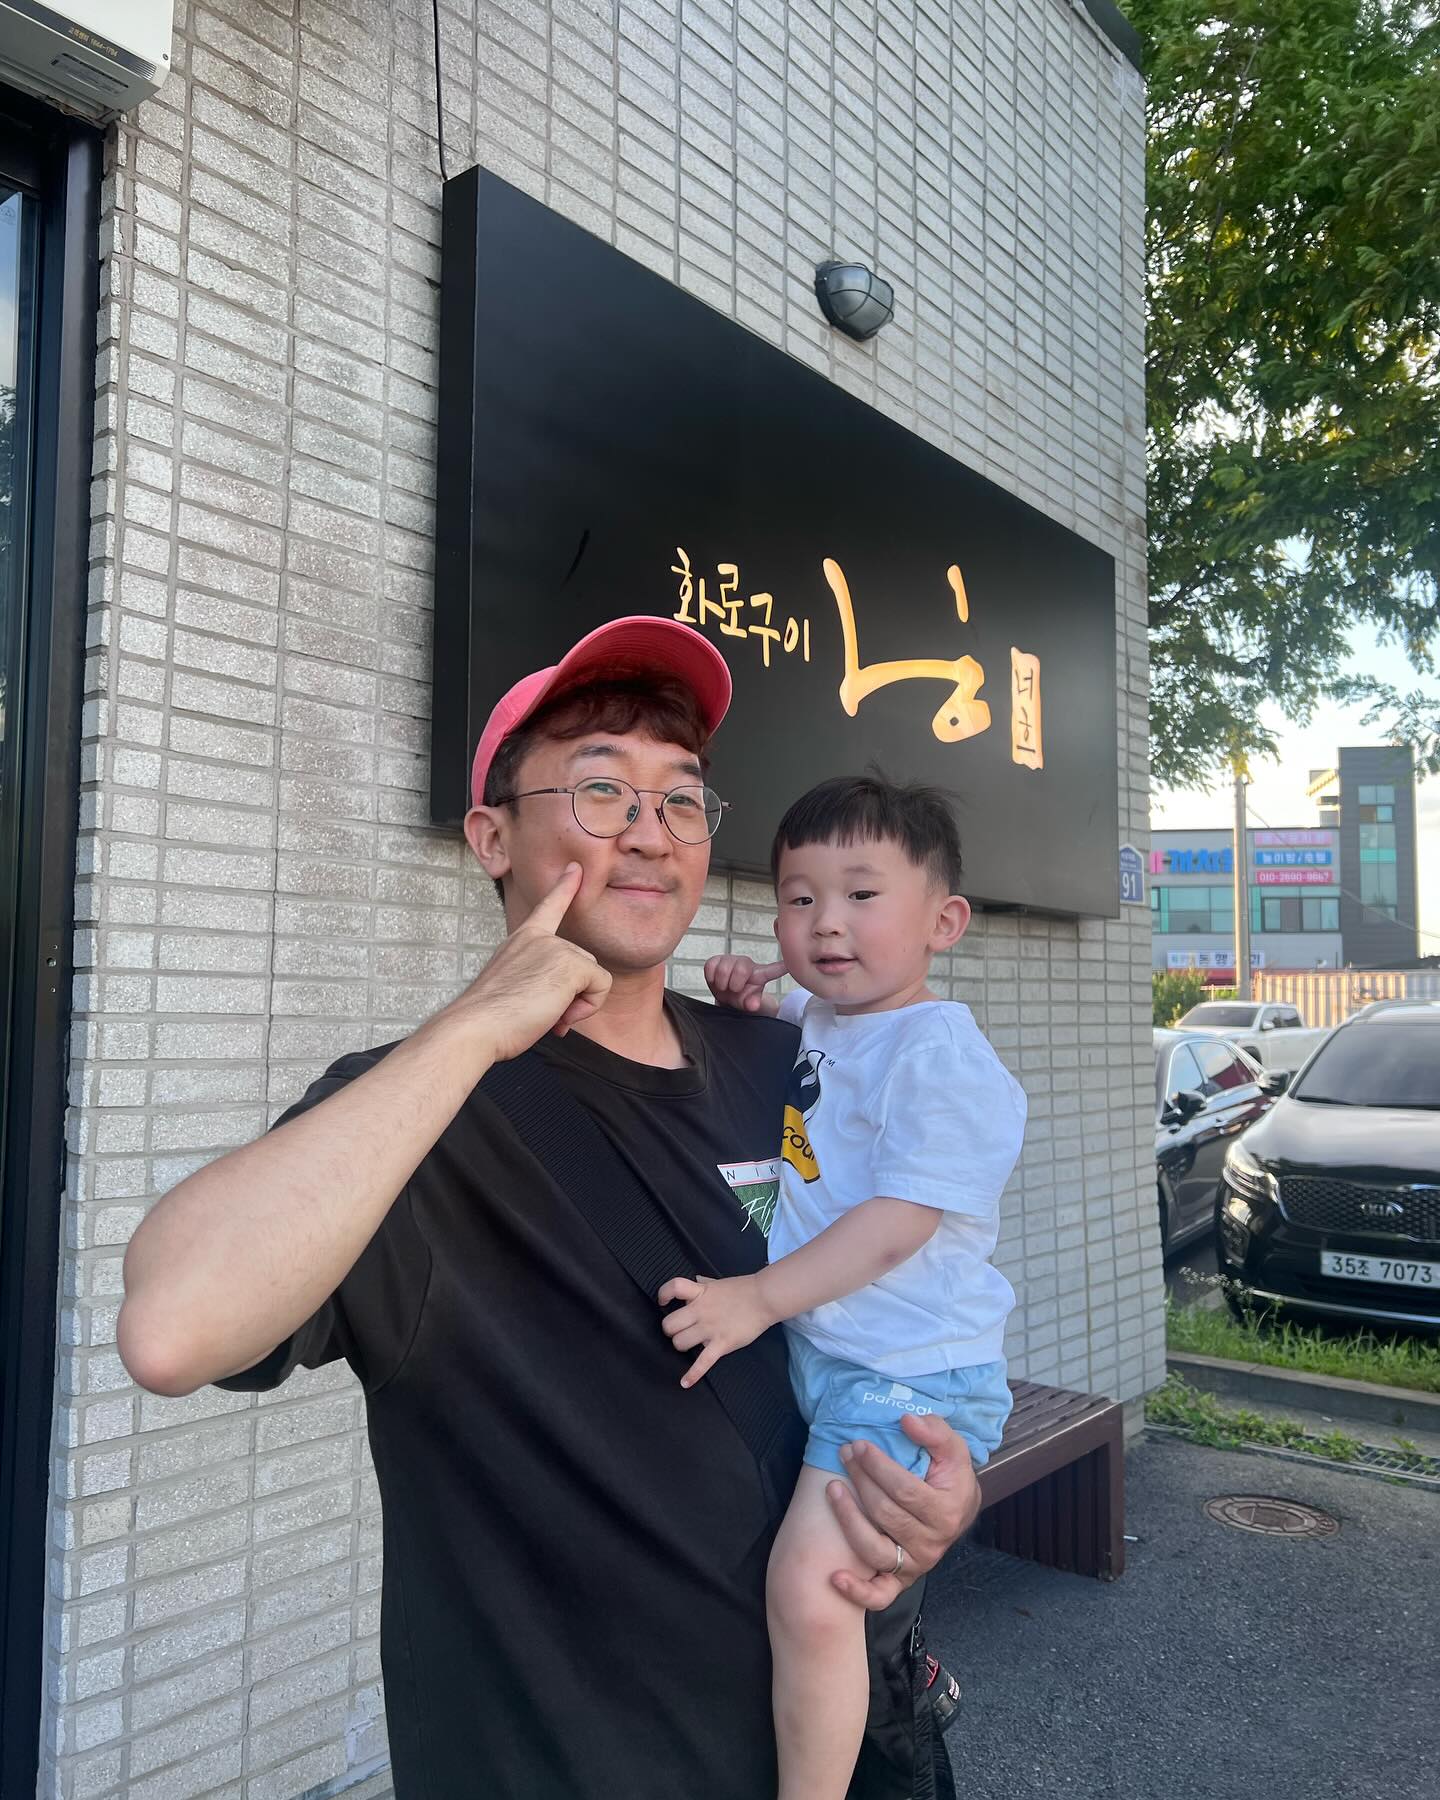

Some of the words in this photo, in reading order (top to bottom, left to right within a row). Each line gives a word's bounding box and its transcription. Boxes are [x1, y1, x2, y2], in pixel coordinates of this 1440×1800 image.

[670, 547, 812, 668] 화로구이
[1122, 871, 1136, 899] 91
[726, 1164, 777, 1181] NIK
[1368, 1202, 1395, 1217] KIA
[1331, 1255, 1371, 1277] 35조
[1379, 1261, 1433, 1284] 7073
